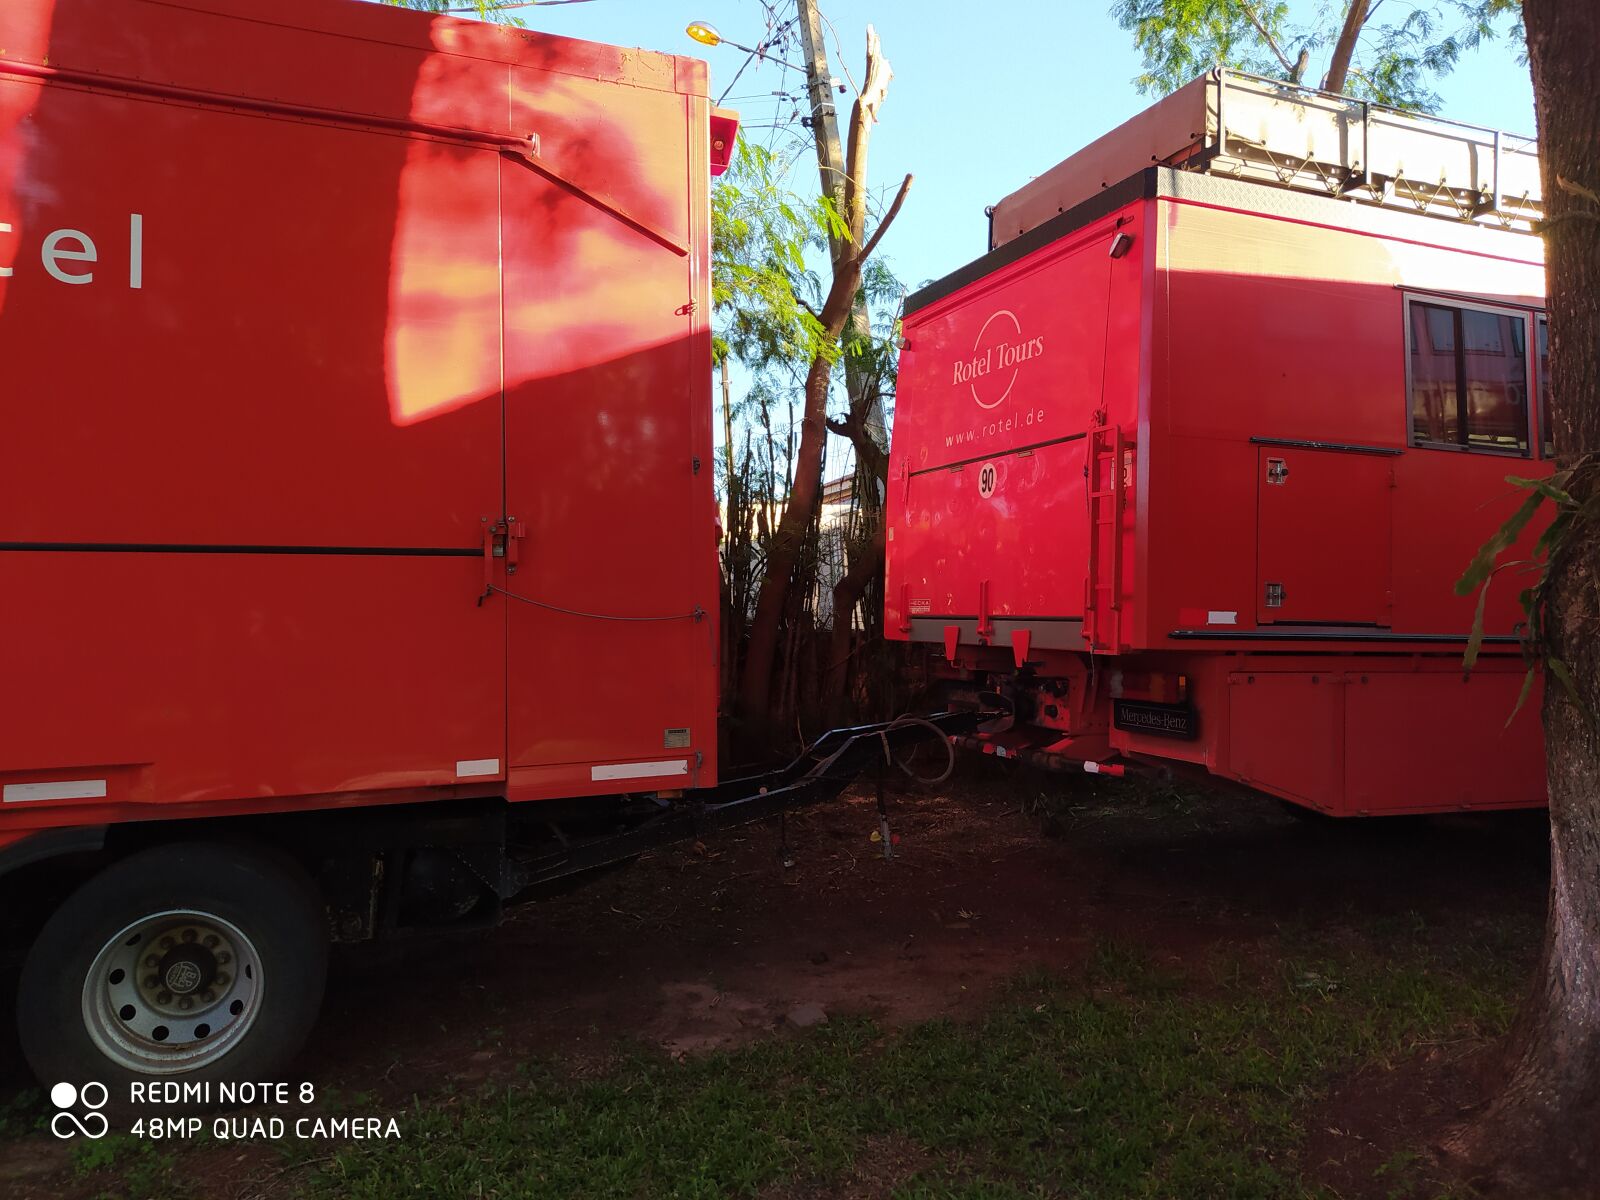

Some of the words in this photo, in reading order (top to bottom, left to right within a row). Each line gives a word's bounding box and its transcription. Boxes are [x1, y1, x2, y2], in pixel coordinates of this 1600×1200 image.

[952, 348, 992, 386] Rotel
[996, 335, 1044, 370] Tours
[945, 407, 1044, 448] www.rotel.de
[981, 467, 994, 493] 90
[1120, 706, 1188, 730] Mercedes-Benz
